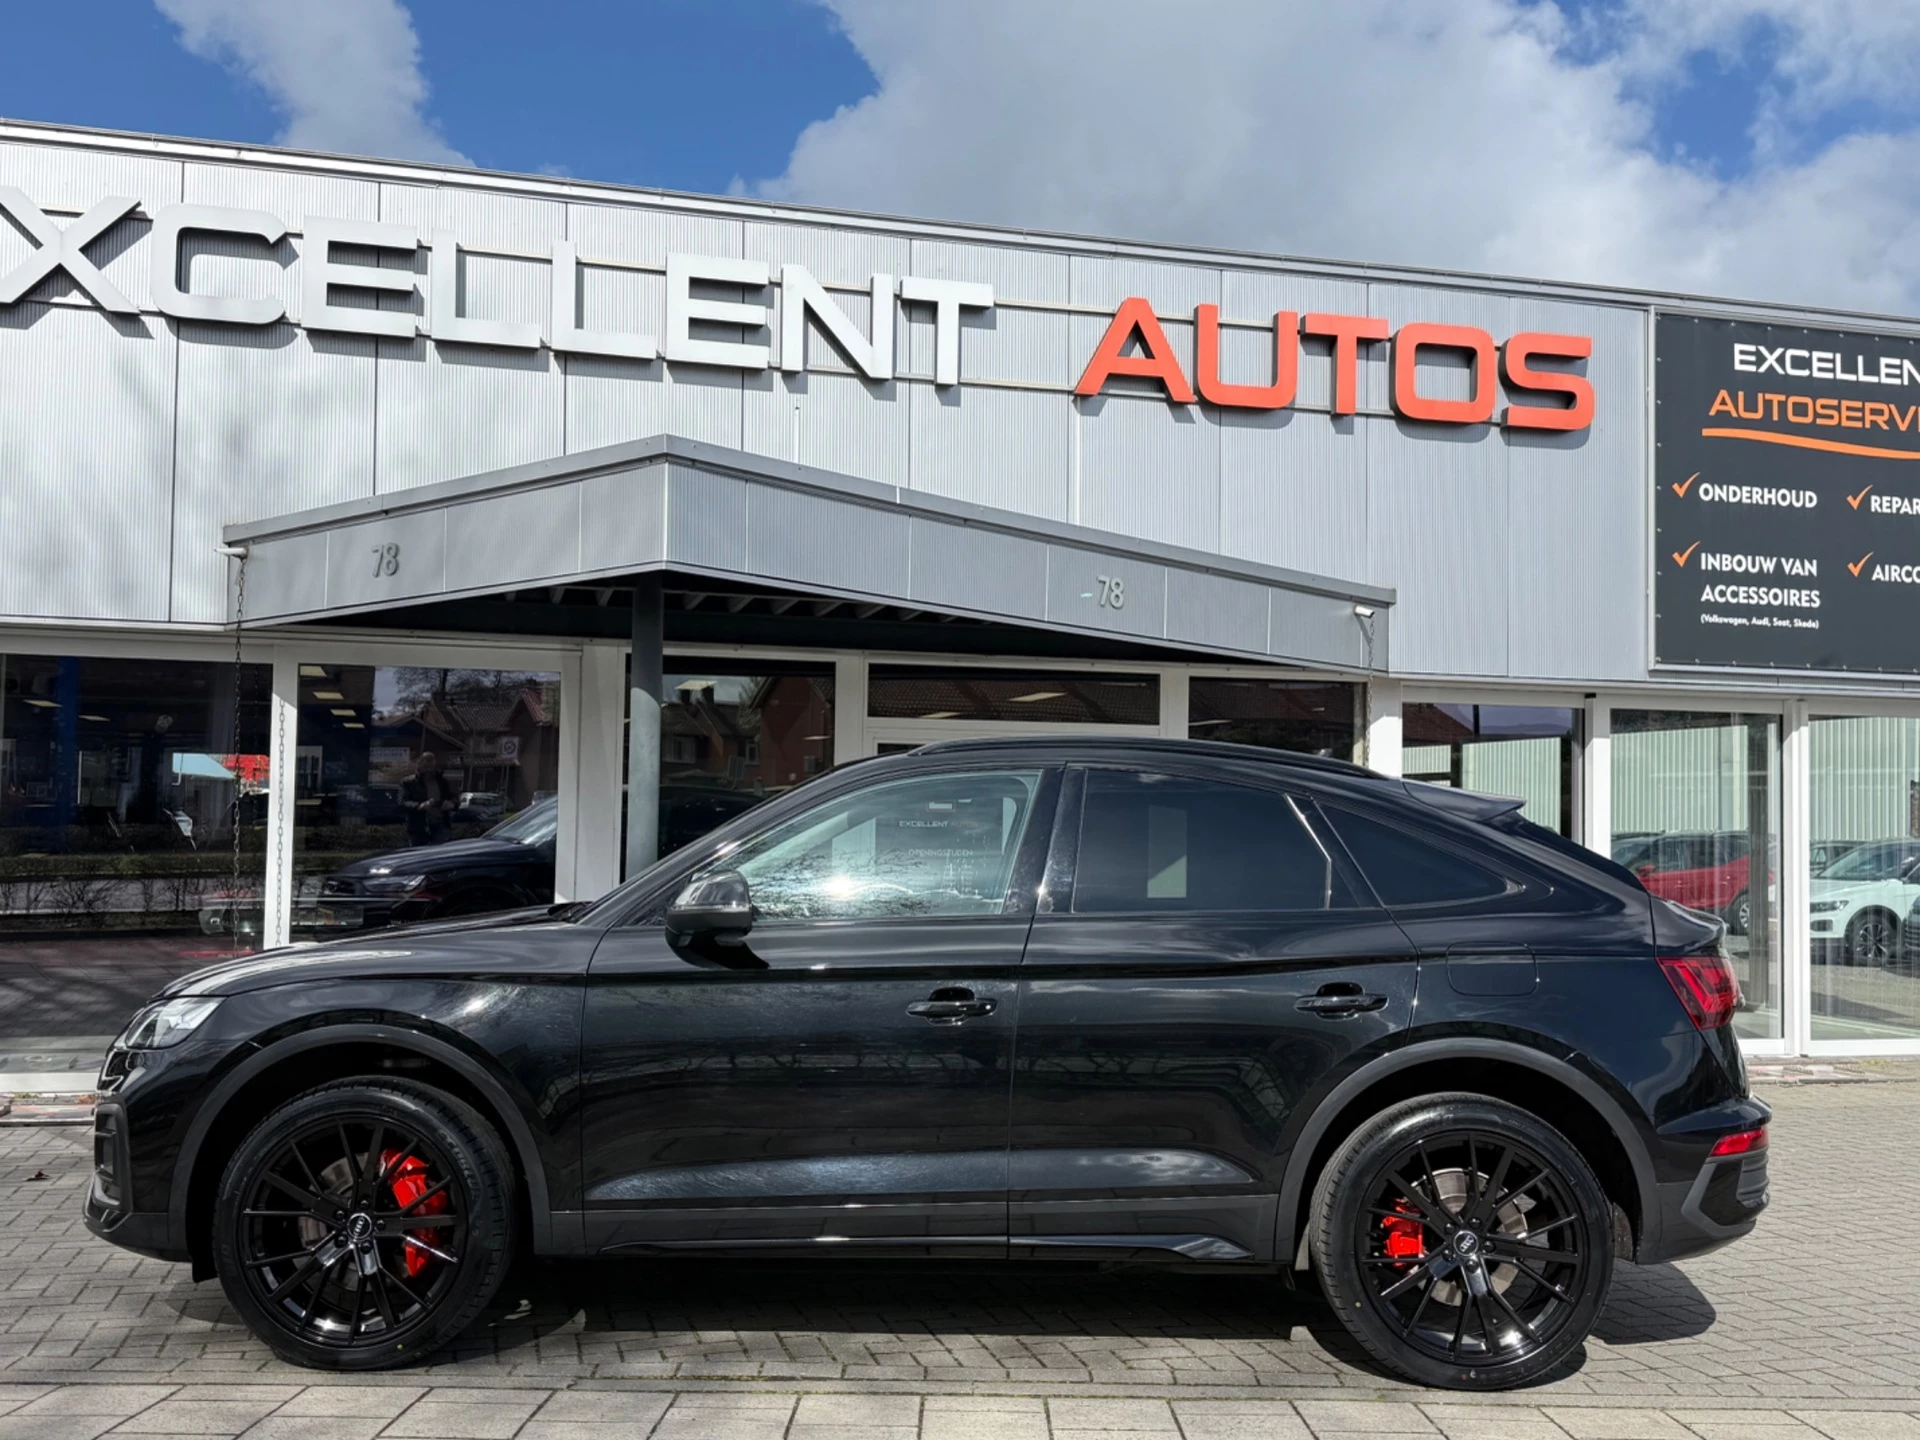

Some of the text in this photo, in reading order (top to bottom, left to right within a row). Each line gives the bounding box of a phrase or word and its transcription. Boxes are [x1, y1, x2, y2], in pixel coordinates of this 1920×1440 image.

[1072, 296, 1595, 431] AUTOS
[1734, 342, 1920, 386] EXCELLEN
[1699, 483, 1818, 508] ONDERHOUD
[371, 542, 400, 578] 78
[1701, 552, 1818, 577] INBOUW VAN
[1096, 575, 1125, 610] 78
[1700, 584, 1821, 608] ACCESSOIRES
[899, 820, 949, 828] EXCELLENT
